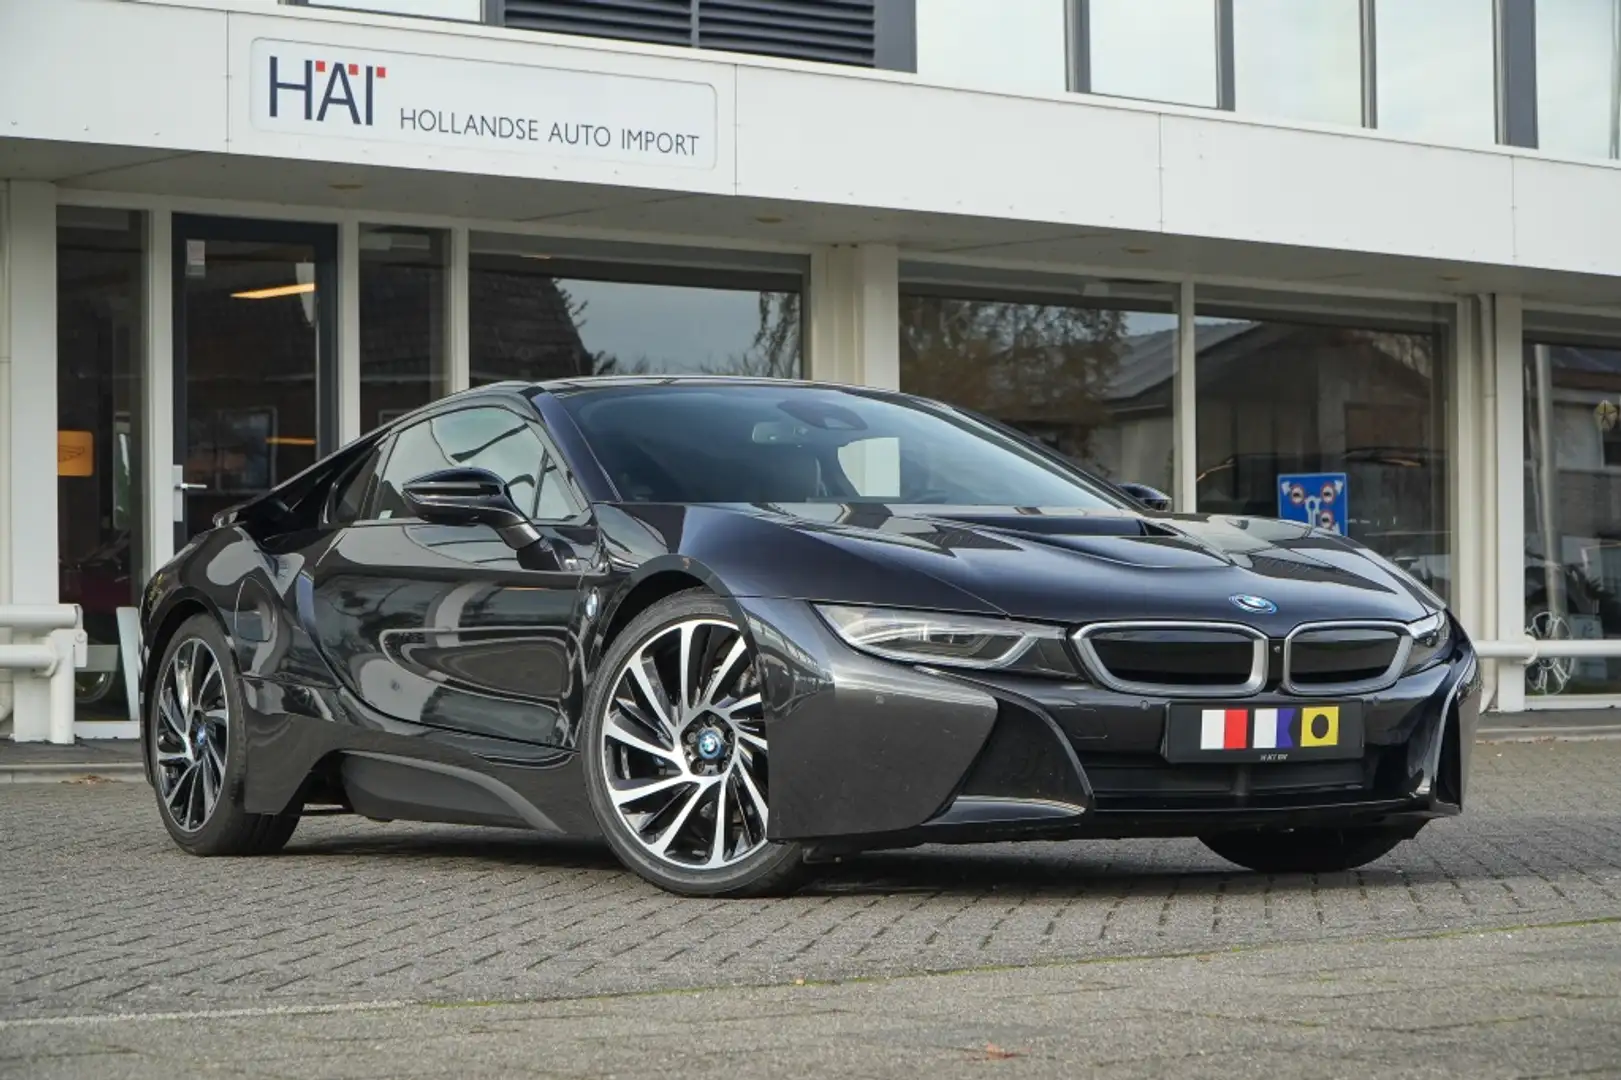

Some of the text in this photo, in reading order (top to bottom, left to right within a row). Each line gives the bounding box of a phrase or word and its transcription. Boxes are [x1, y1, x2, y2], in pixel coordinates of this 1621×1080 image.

[400, 107, 700, 156] HOLLANDSE AUTO IMPORT
